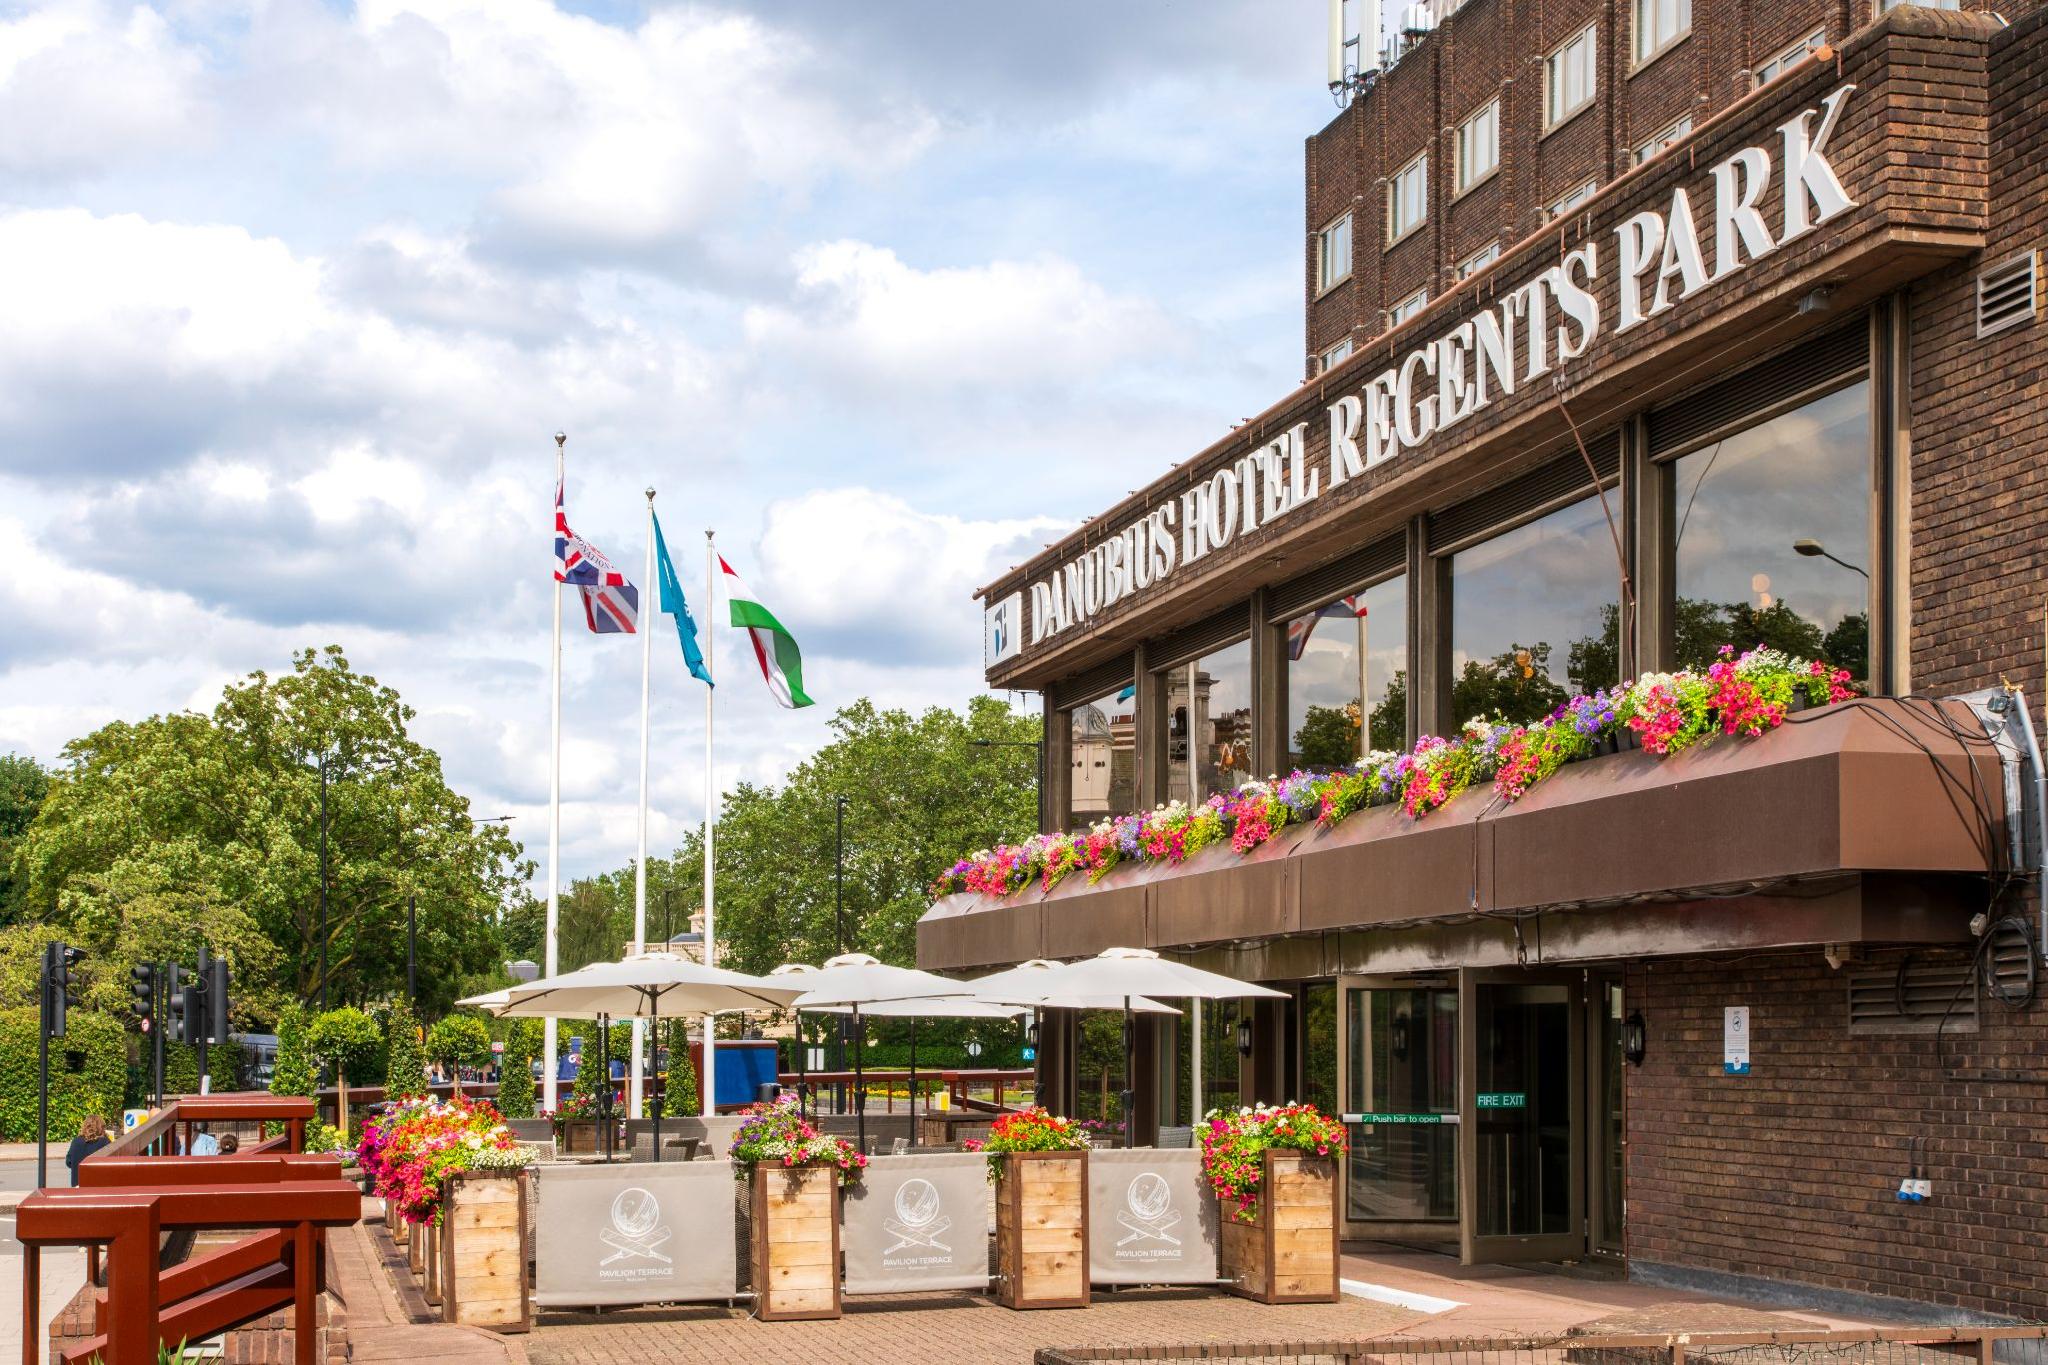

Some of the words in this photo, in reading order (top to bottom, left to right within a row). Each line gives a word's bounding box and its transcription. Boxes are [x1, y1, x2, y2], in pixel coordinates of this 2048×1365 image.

[1030, 500, 1176, 646] DANUBIUS
[1179, 422, 1319, 567] HOTEL
[1326, 243, 1600, 491] REGENTS
[1613, 84, 1860, 336] PARK
[1477, 1095, 1499, 1106] FIRE
[1502, 1095, 1525, 1106] EXIT
[1372, 1114, 1392, 1123] Push
[1393, 1114, 1406, 1123] bar
[1409, 1114, 1418, 1123] to
[1418, 1115, 1439, 1124] open
[1115, 1249, 1149, 1257] PAVILION
[1150, 1248, 1182, 1257] TERRACE
[883, 1258, 918, 1267] PAVILION
[919, 1256, 953, 1265] TERRACE
[599, 1269, 636, 1278] PAVILION
[638, 1267, 674, 1276] TERRACE
